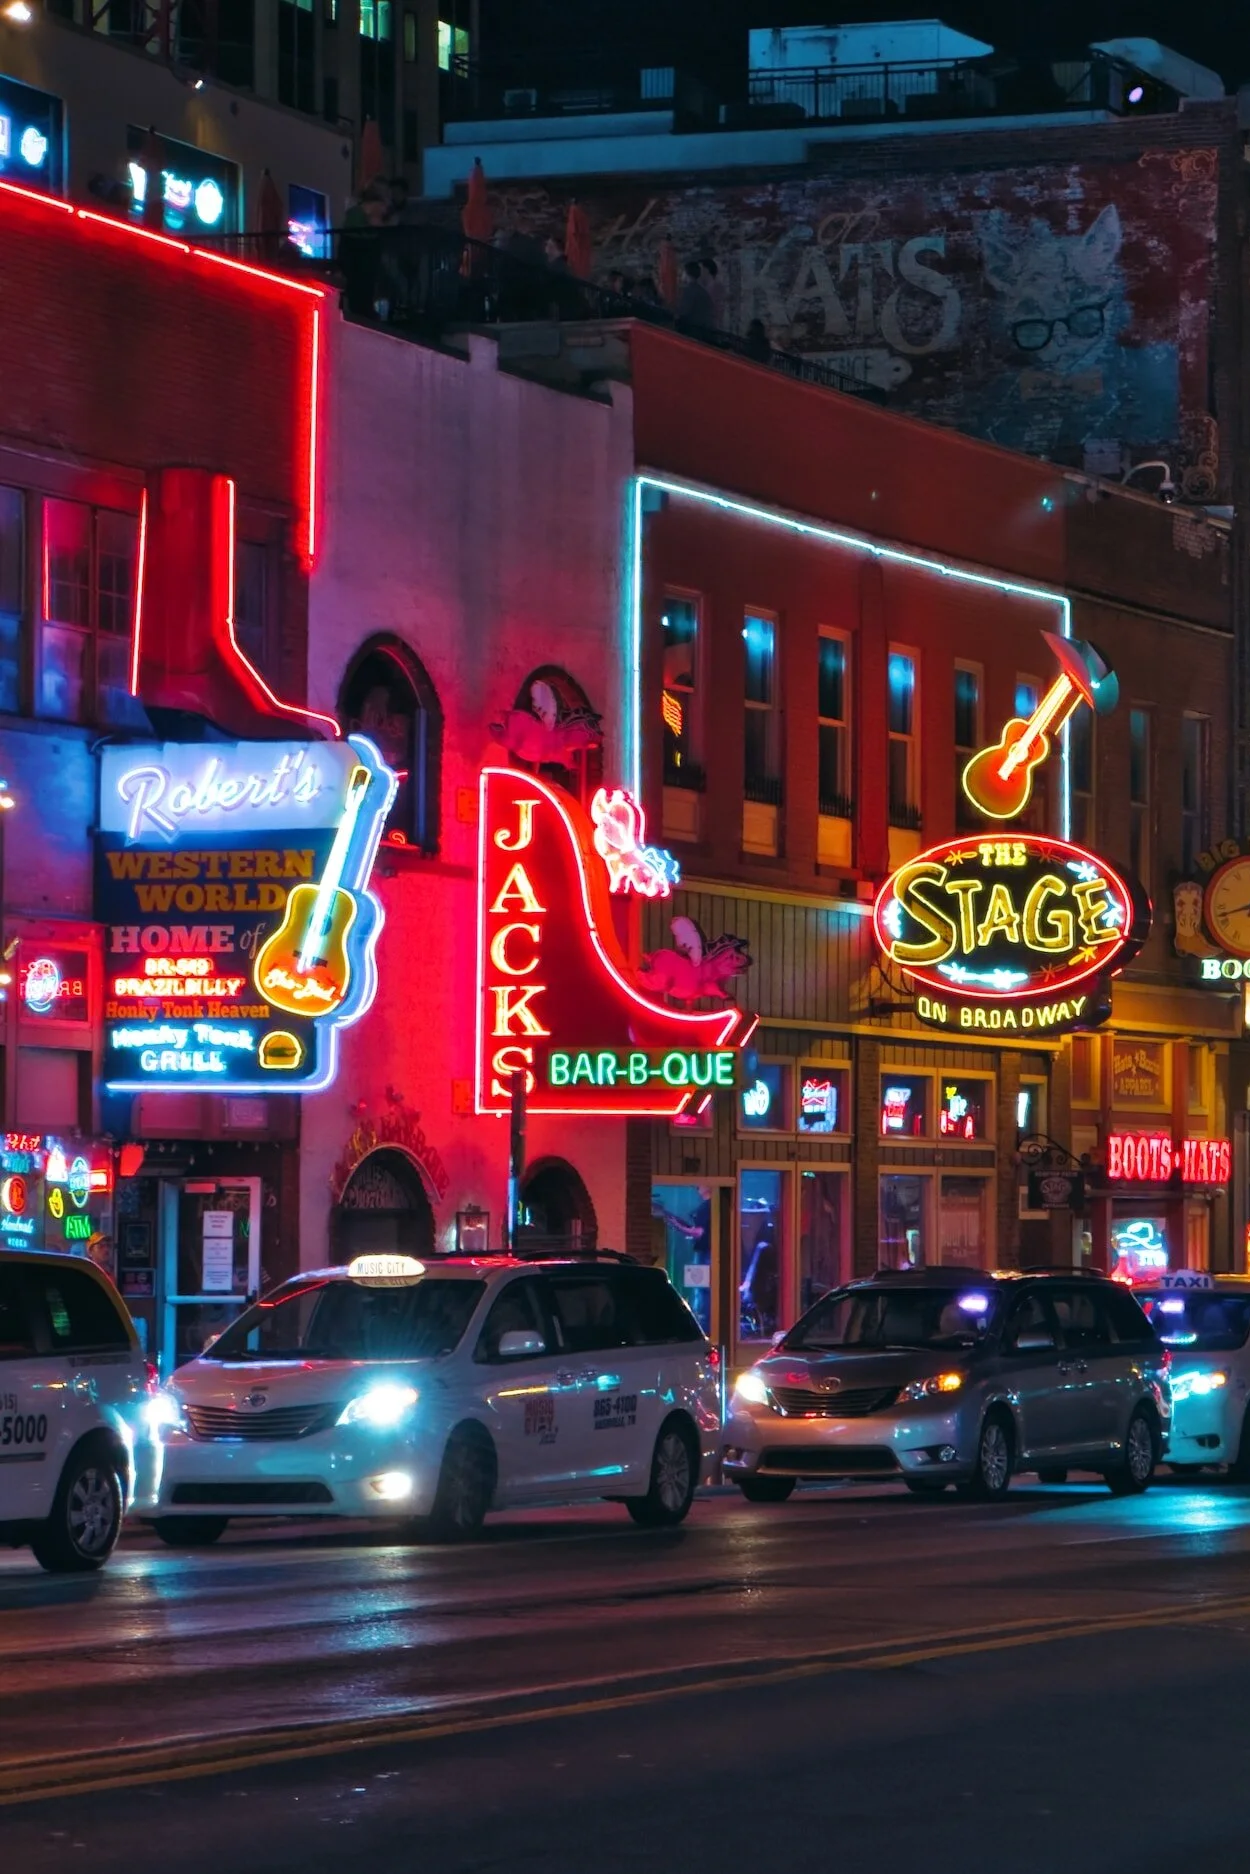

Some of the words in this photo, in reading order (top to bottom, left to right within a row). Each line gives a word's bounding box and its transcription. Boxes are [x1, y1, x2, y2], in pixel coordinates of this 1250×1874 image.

[118, 750, 322, 846] Robert's
[106, 849, 316, 881] WESTERN
[978, 842, 1027, 867] THE
[134, 884, 288, 912] WORLD
[891, 861, 1121, 967] STAGE
[110, 925, 236, 954] HOME
[240, 921, 267, 960] of
[489, 799, 551, 1097] JACKS
[105, 1000, 160, 1023] Honky
[162, 1000, 204, 1019] Tonk
[207, 1002, 270, 1019] Heaven
[917, 996, 947, 1023] ON
[960, 996, 1086, 1029] BROADWAY
[112, 1025, 188, 1049] Honky
[193, 1023, 255, 1051] Tonk
[140, 1049, 227, 1072] GRILL
[550, 1051, 735, 1086] BAR-B-QUE
[1108, 1135, 1172, 1181] BOOTS
[1182, 1138, 1232, 1183] HATS
[65, 1214, 91, 1239] ATM
[357, 1262, 383, 1275] MUSIC
[387, 1262, 406, 1274] CITY
[1161, 1276, 1209, 1288] TAXI
[0, 1393, 18, 1414] 15)
[0, 1414, 48, 1446] 5000
